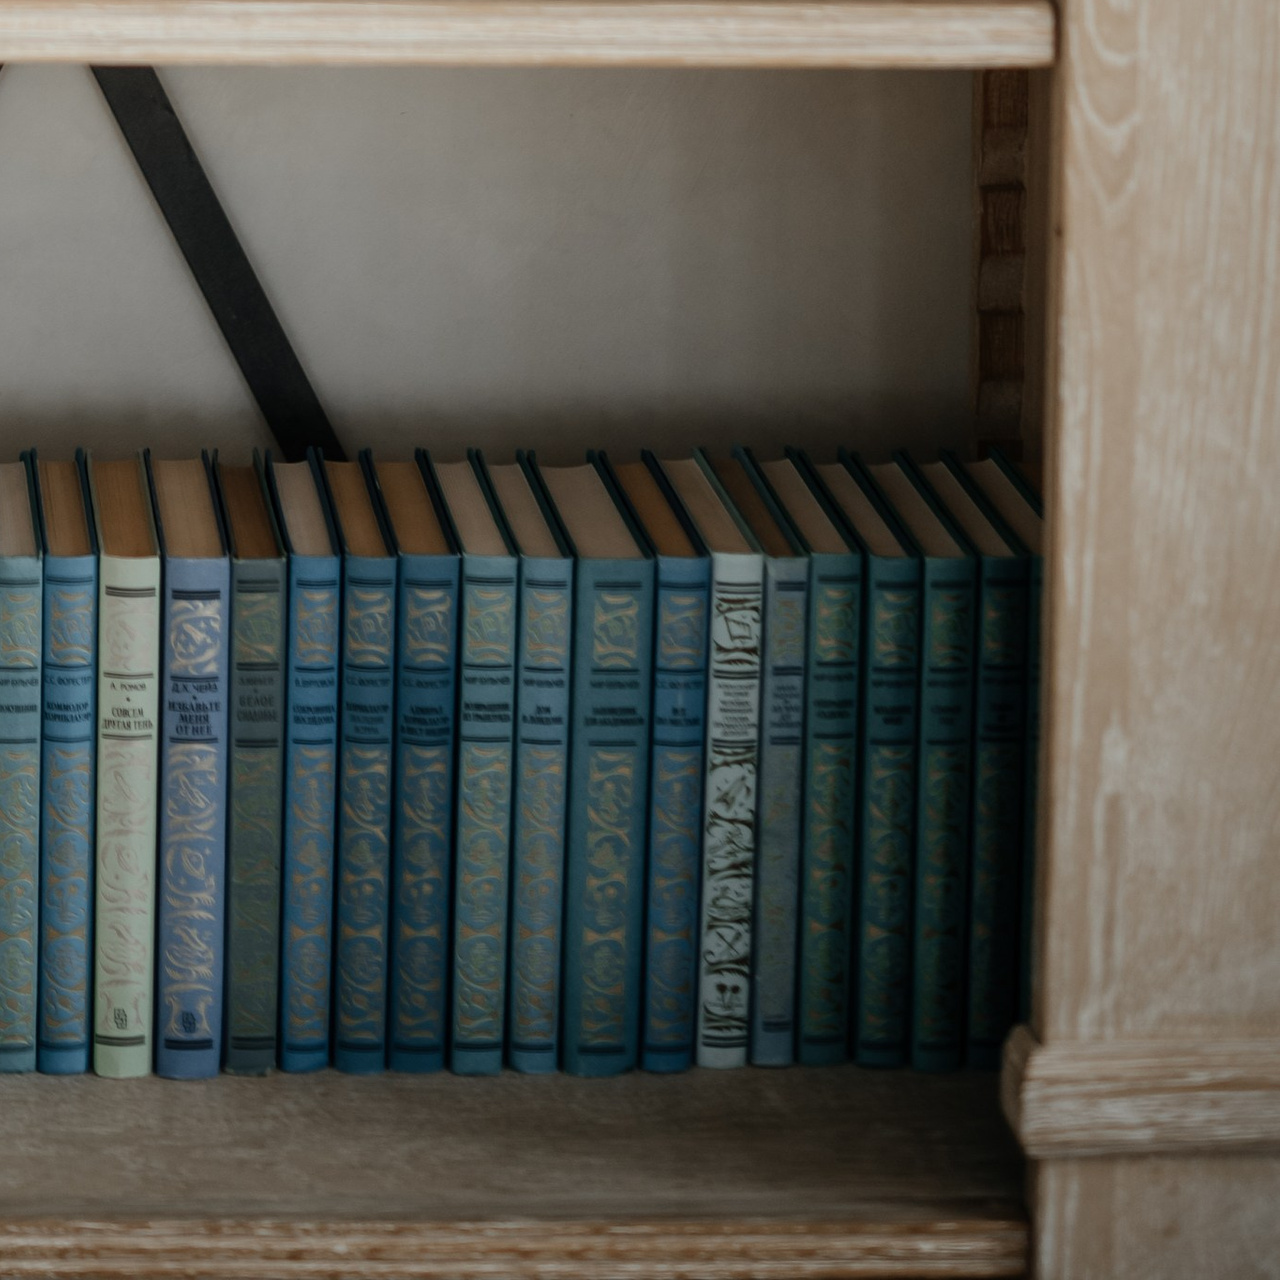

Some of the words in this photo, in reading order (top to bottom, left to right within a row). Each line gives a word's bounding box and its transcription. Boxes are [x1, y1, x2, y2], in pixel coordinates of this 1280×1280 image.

[169, 701, 220, 712] ИЗБАВЬТЕ
[239, 695, 274, 708] БЕЛОЕ
[111, 707, 144, 718] СОВСЕМ
[178, 713, 209, 724] МЕНЯ
[104, 719, 131, 730] ДРУГАЯ
[133, 719, 153, 729] ТЕНЬ
[176, 725, 188, 735] ОТ
[191, 725, 212, 735] НЕЕ
